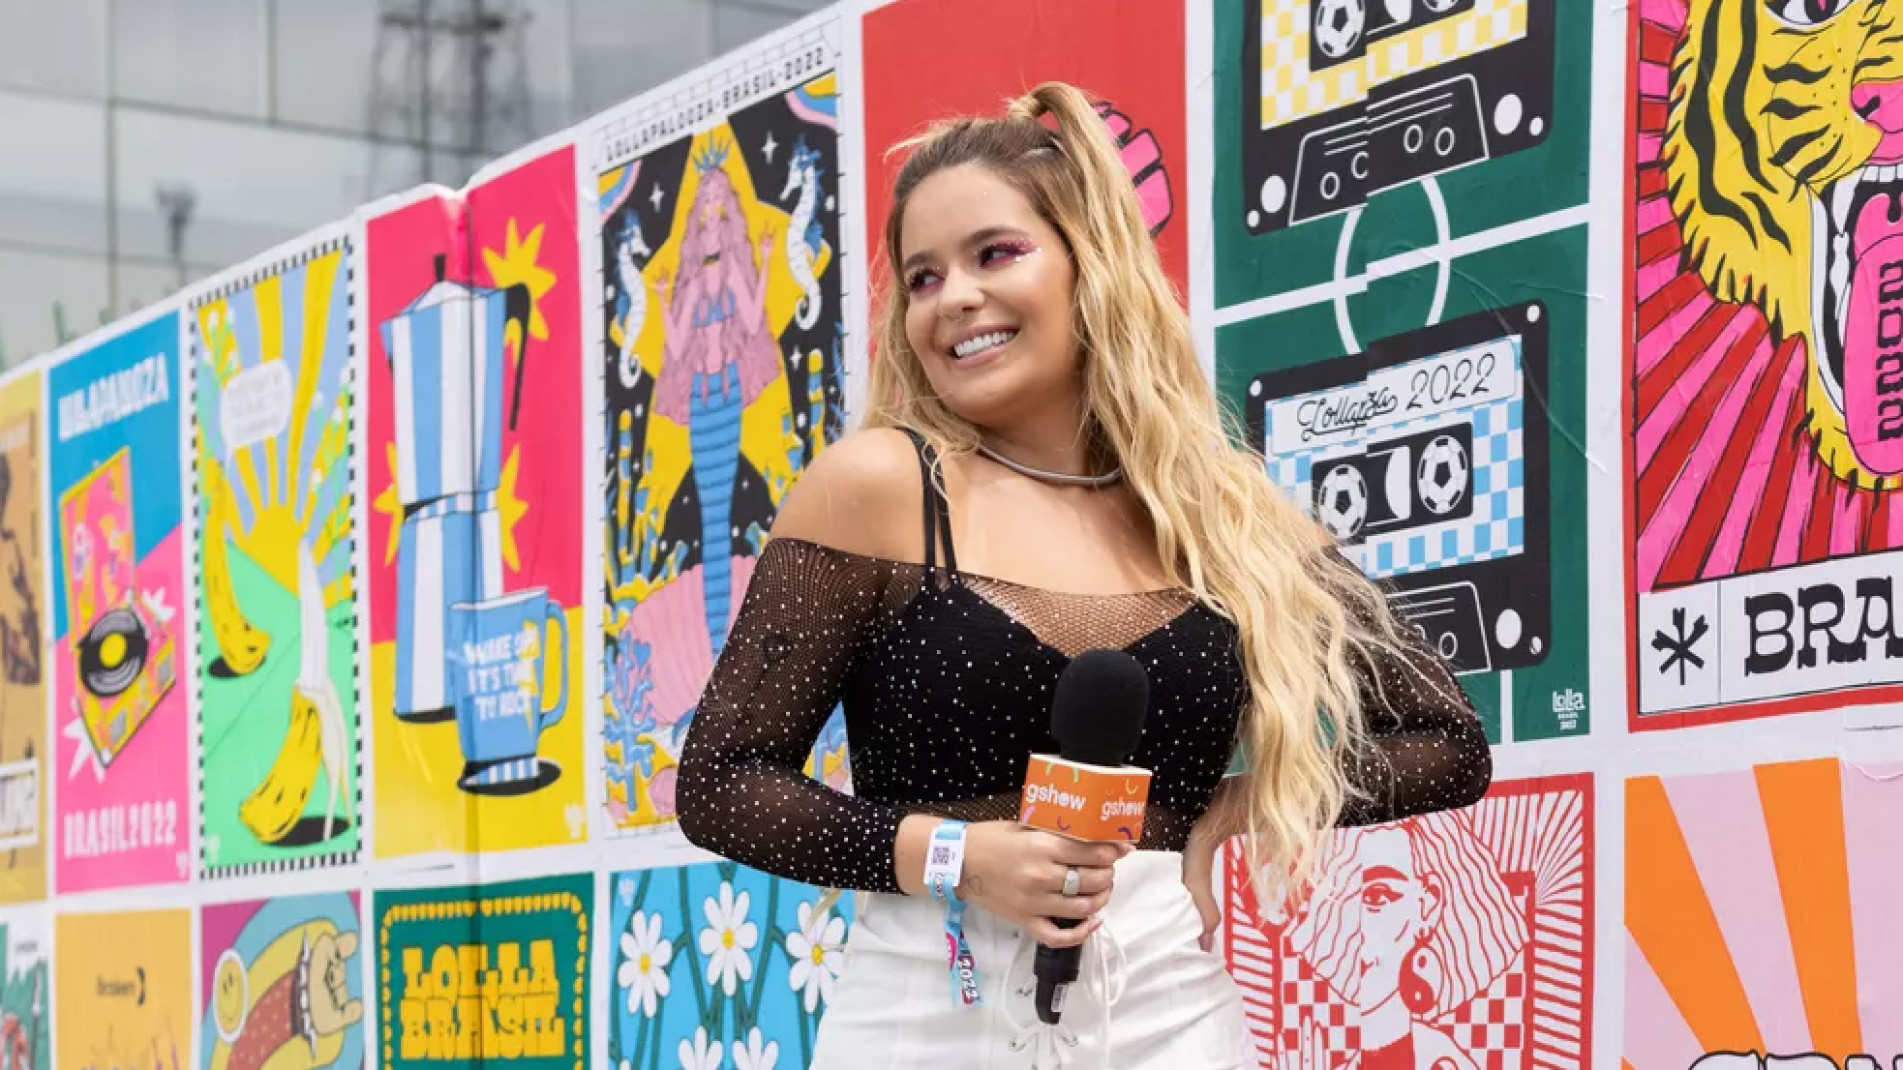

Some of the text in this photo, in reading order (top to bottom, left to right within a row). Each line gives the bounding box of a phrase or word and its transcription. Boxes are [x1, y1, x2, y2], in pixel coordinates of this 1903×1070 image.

[1406, 353, 1495, 410] 2022
[1744, 575, 1903, 677] BRA
[1026, 783, 1086, 811] gshow
[1101, 797, 1145, 821] gshow
[402, 939, 560, 1001] LOLLA
[400, 993, 565, 1060] BRASIL
